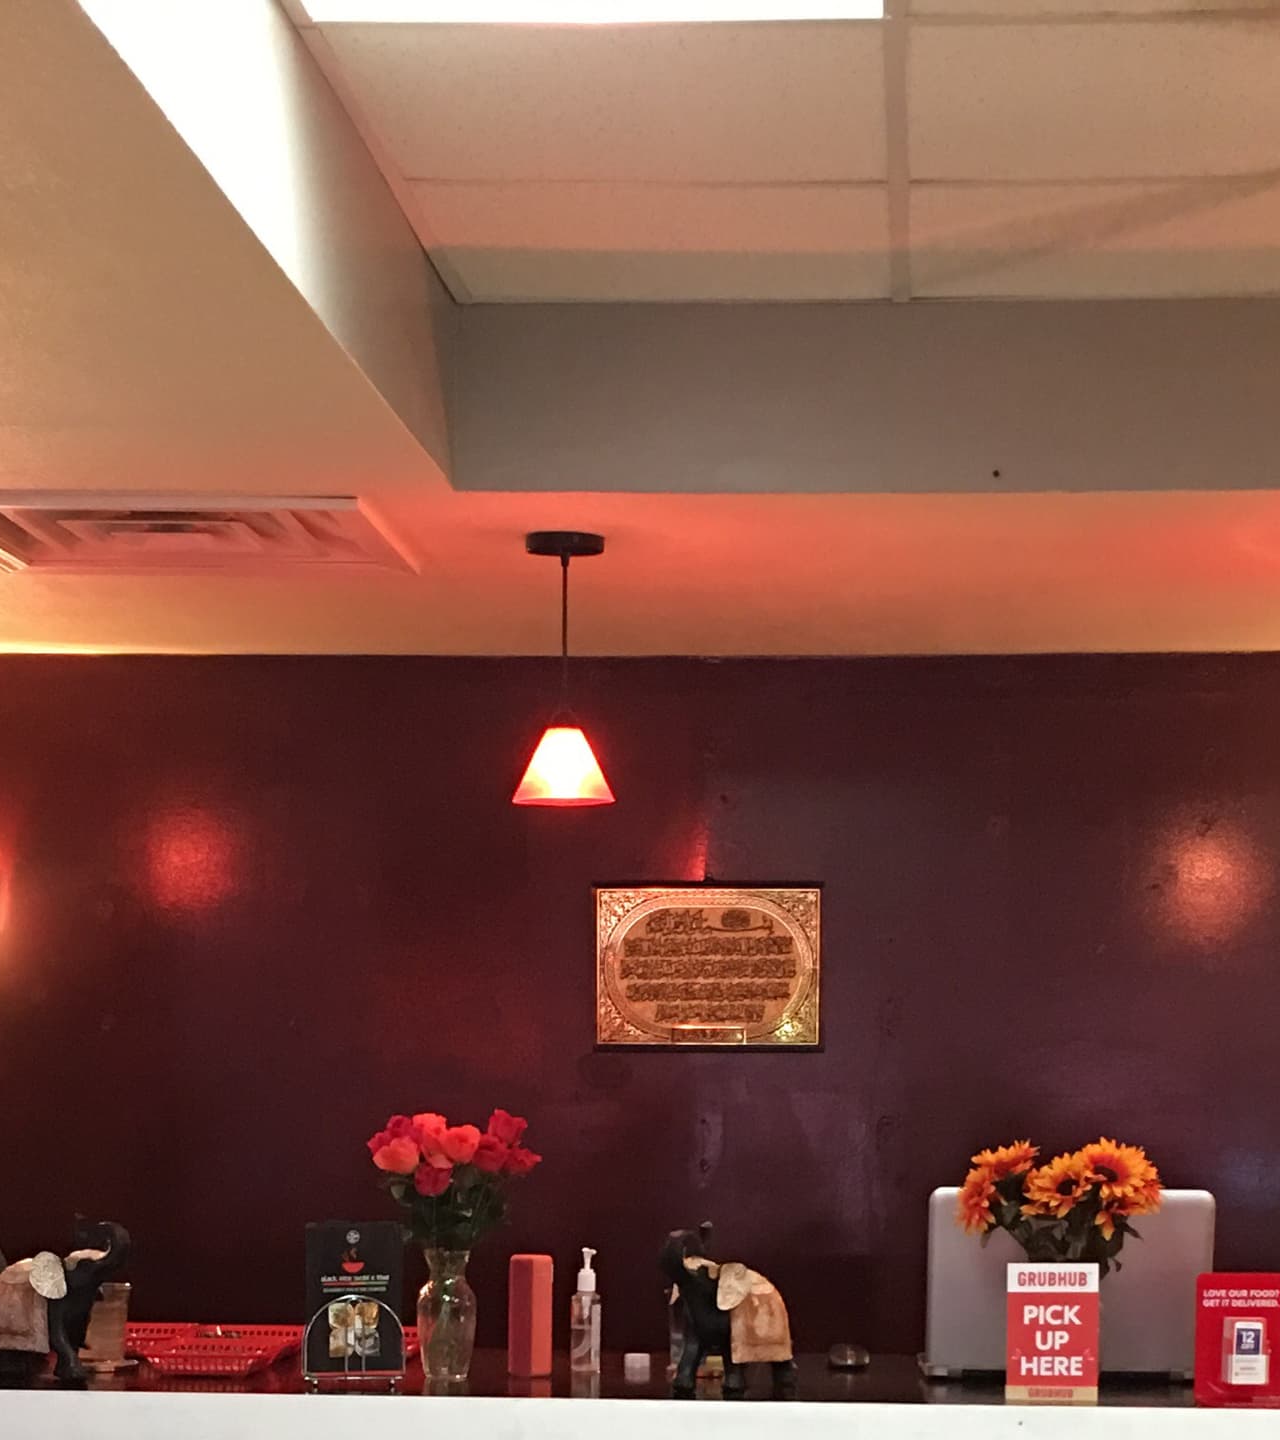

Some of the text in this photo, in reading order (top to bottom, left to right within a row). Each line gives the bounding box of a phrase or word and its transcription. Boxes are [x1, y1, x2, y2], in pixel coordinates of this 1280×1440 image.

[1018, 1271, 1087, 1287] GRUBHUB
[1203, 1289, 1280, 1298] LOVE OUR FOOD?
[1202, 1299, 1220, 1308] GET
[1221, 1299, 1230, 1308] IT
[1023, 1305, 1082, 1325] PICK
[1035, 1331, 1069, 1350] UP
[1020, 1356, 1083, 1376] HERE
